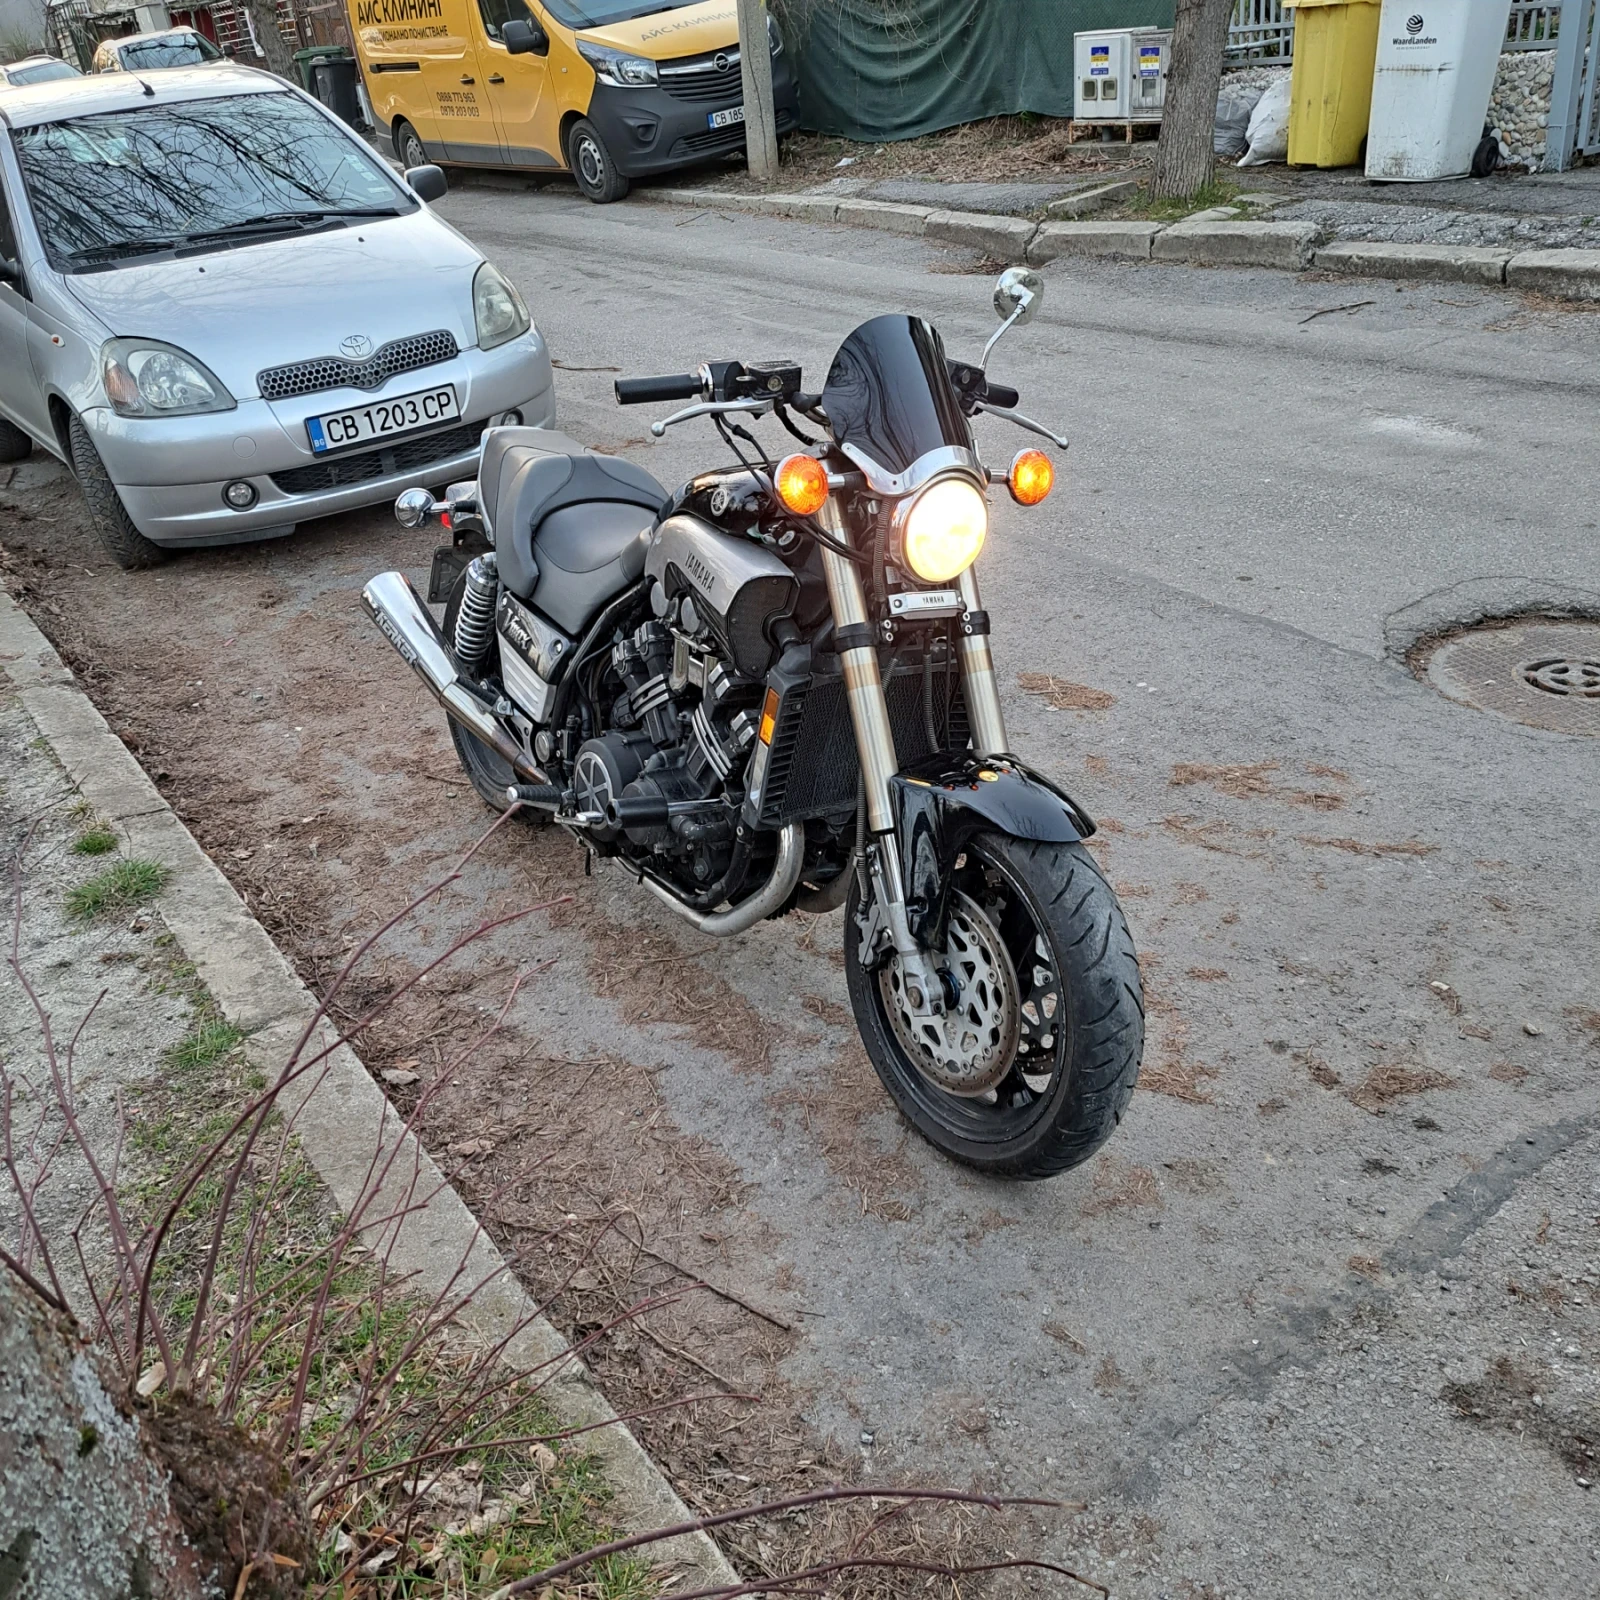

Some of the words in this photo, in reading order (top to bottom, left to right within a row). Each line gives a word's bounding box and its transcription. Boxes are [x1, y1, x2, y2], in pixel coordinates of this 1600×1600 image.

[1392, 36, 1437, 45] WaardLanden
[451, 92, 463, 103] 773
[314, 438, 325, 448] BG
[363, 400, 420, 434] 1203
[685, 550, 715, 593] YAMAHA
[922, 595, 945, 605] YAMAHA
[375, 611, 417, 664] KERKER
